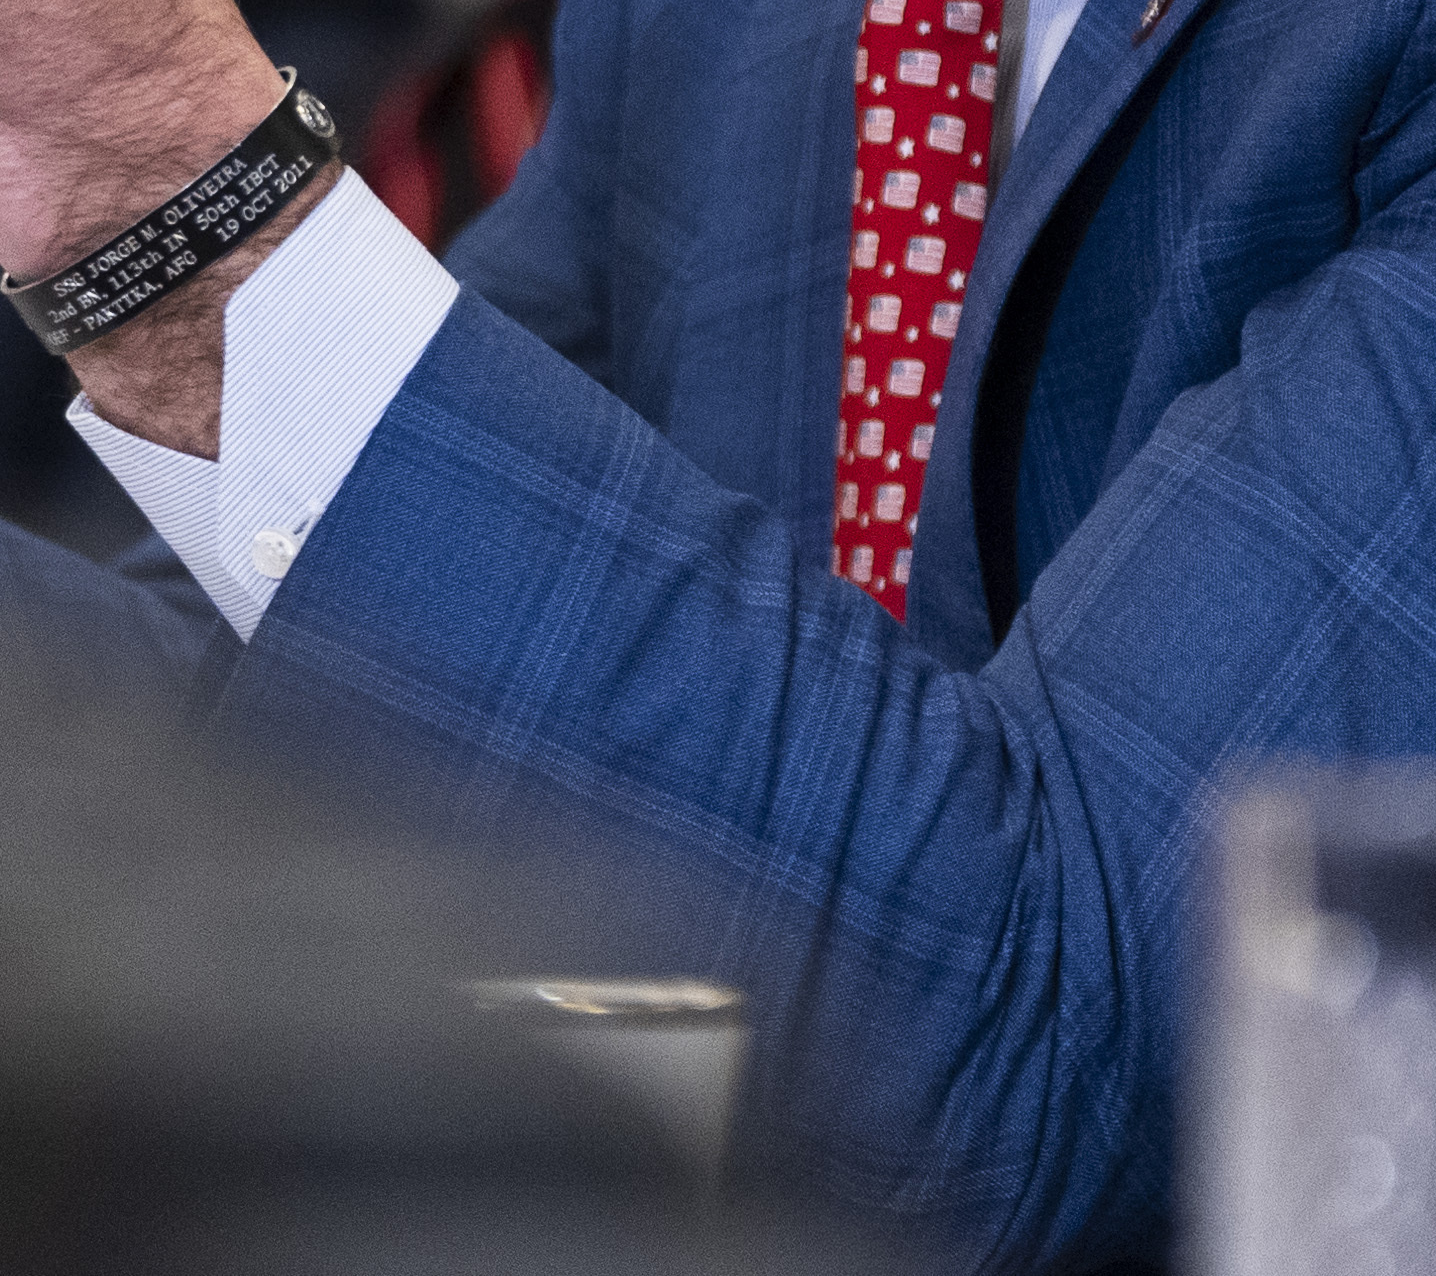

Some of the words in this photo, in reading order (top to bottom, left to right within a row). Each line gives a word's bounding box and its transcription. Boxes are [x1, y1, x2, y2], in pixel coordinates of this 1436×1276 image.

[48, 302, 78, 324] 2nd
[77, 288, 109, 310] BN,
[108, 250, 164, 291] 113th
[162, 229, 188, 253] IN
[195, 194, 241, 231] 50th
[238, 153, 280, 195] IBCT
[53, 272, 86, 297] SSG
[87, 236, 142, 279] JORGE
[140, 224, 163, 242] M.
[164, 158, 248, 225] OLIVEIRA
[83, 280, 164, 331] PAKTIKA,
[164, 250, 198, 280] AFG
[216, 218, 240, 243] 19
[241, 188, 275, 222] OCT
[274, 155, 313, 194] 2011
